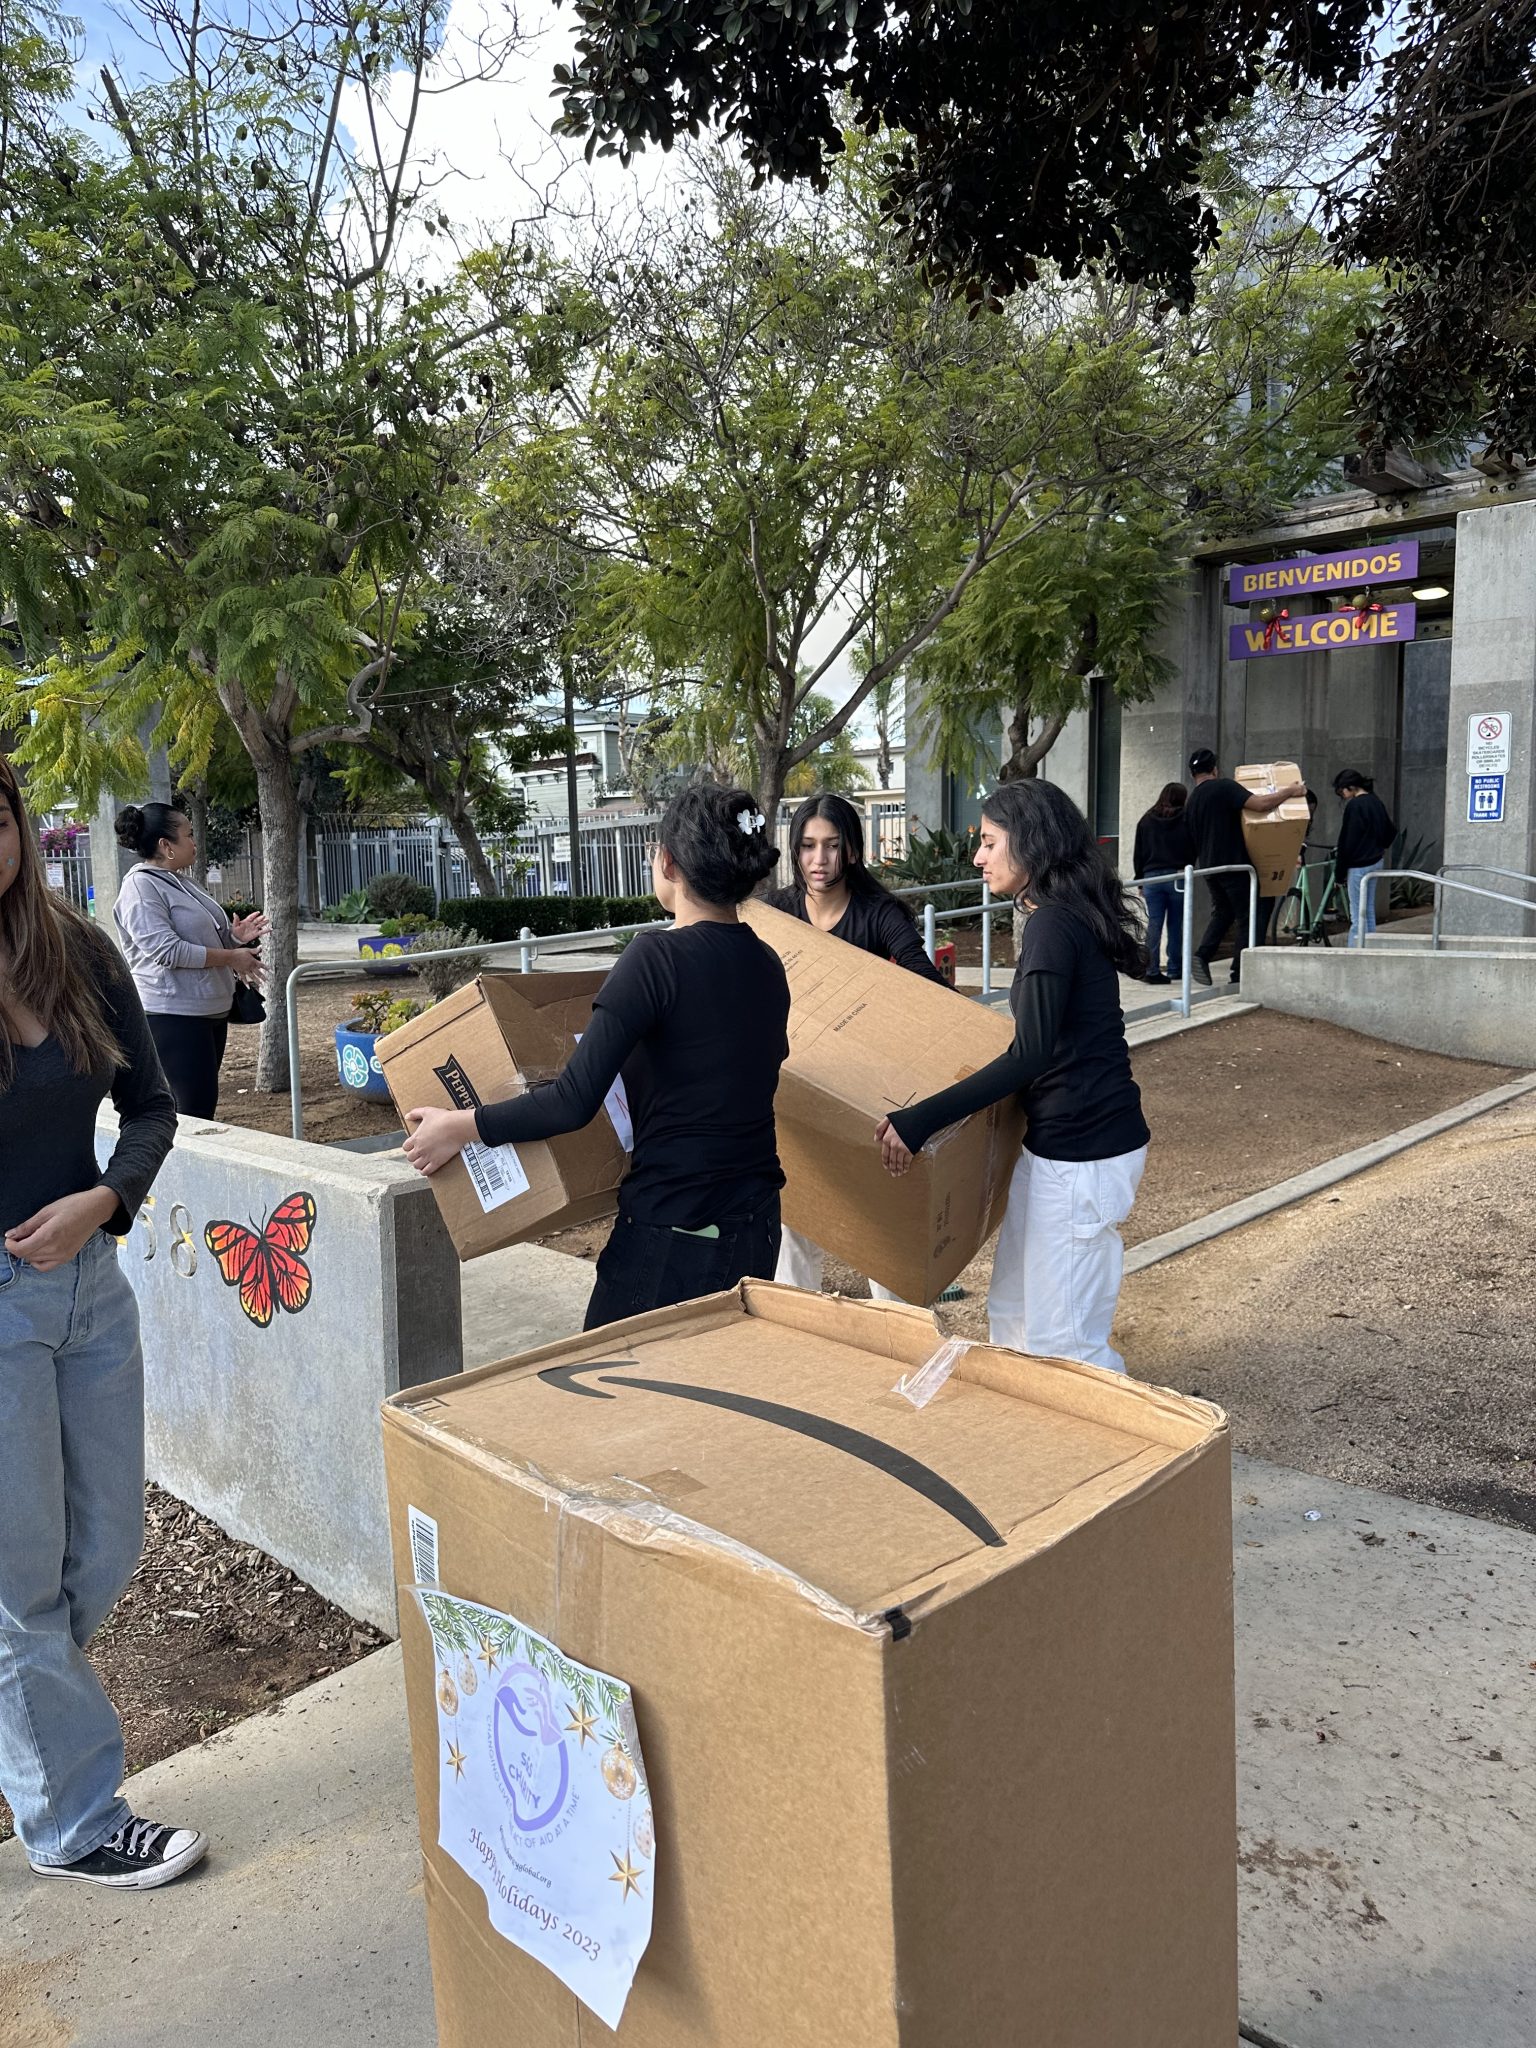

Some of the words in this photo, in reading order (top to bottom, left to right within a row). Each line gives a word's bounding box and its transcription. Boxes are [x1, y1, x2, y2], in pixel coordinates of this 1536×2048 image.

[1243, 552, 1402, 593] BIENVENIDOS
[1245, 611, 1398, 653] WELCOME
[833, 1020, 848, 1032] MADE
[852, 1002, 868, 1016] CHINA
[525, 1837, 536, 1849] OF
[540, 1832, 554, 1847] AID
[555, 1824, 564, 1839] AT
[564, 1818, 571, 1828] A
[495, 1874, 560, 1931] Holidays
[562, 1923, 601, 1962] 2023
